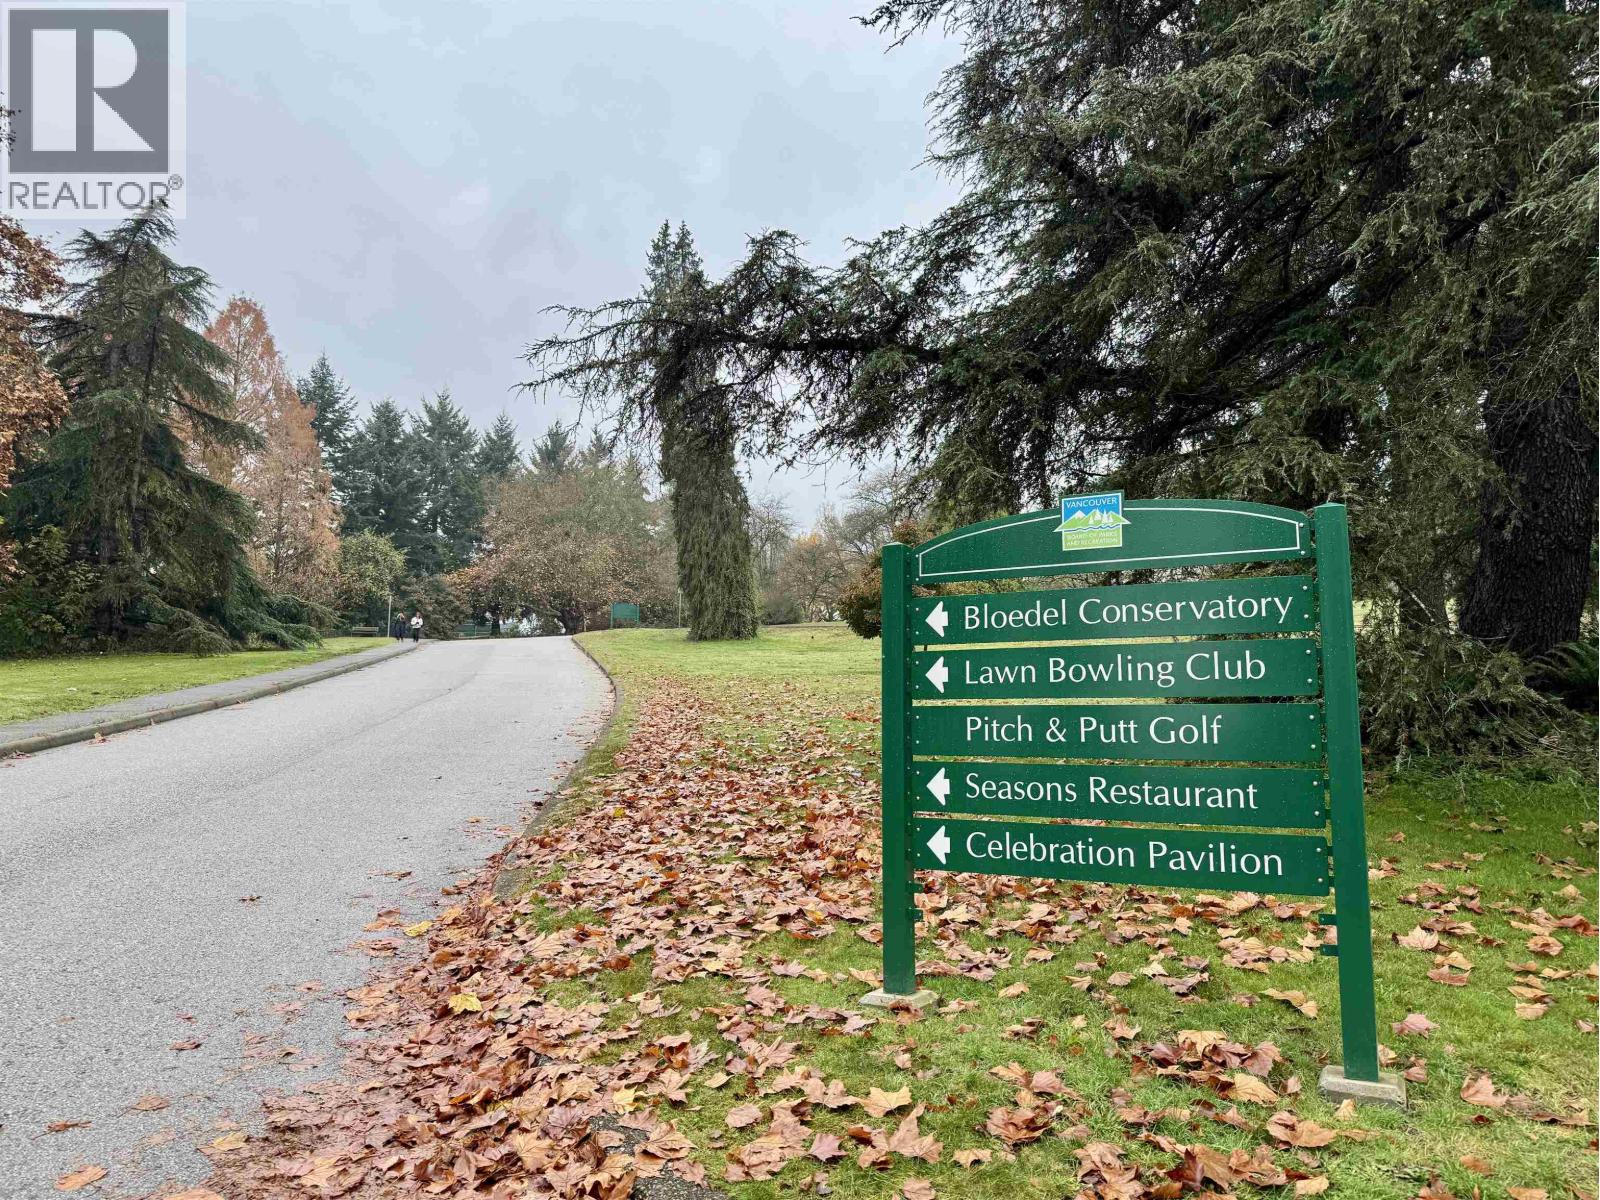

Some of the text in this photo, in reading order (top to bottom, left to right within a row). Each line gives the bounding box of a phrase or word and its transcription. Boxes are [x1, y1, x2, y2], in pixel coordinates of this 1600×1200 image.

[1065, 497, 1118, 509] VANCOUVER
[965, 594, 1293, 630] Bloedel Conservatory
[965, 650, 1266, 688] Lawn Bowling Club
[966, 714, 1222, 744] Pitch & Putt Golf
[966, 772, 1258, 809] Seasons Restaurant
[966, 831, 1283, 876] Celebration Pavilion
